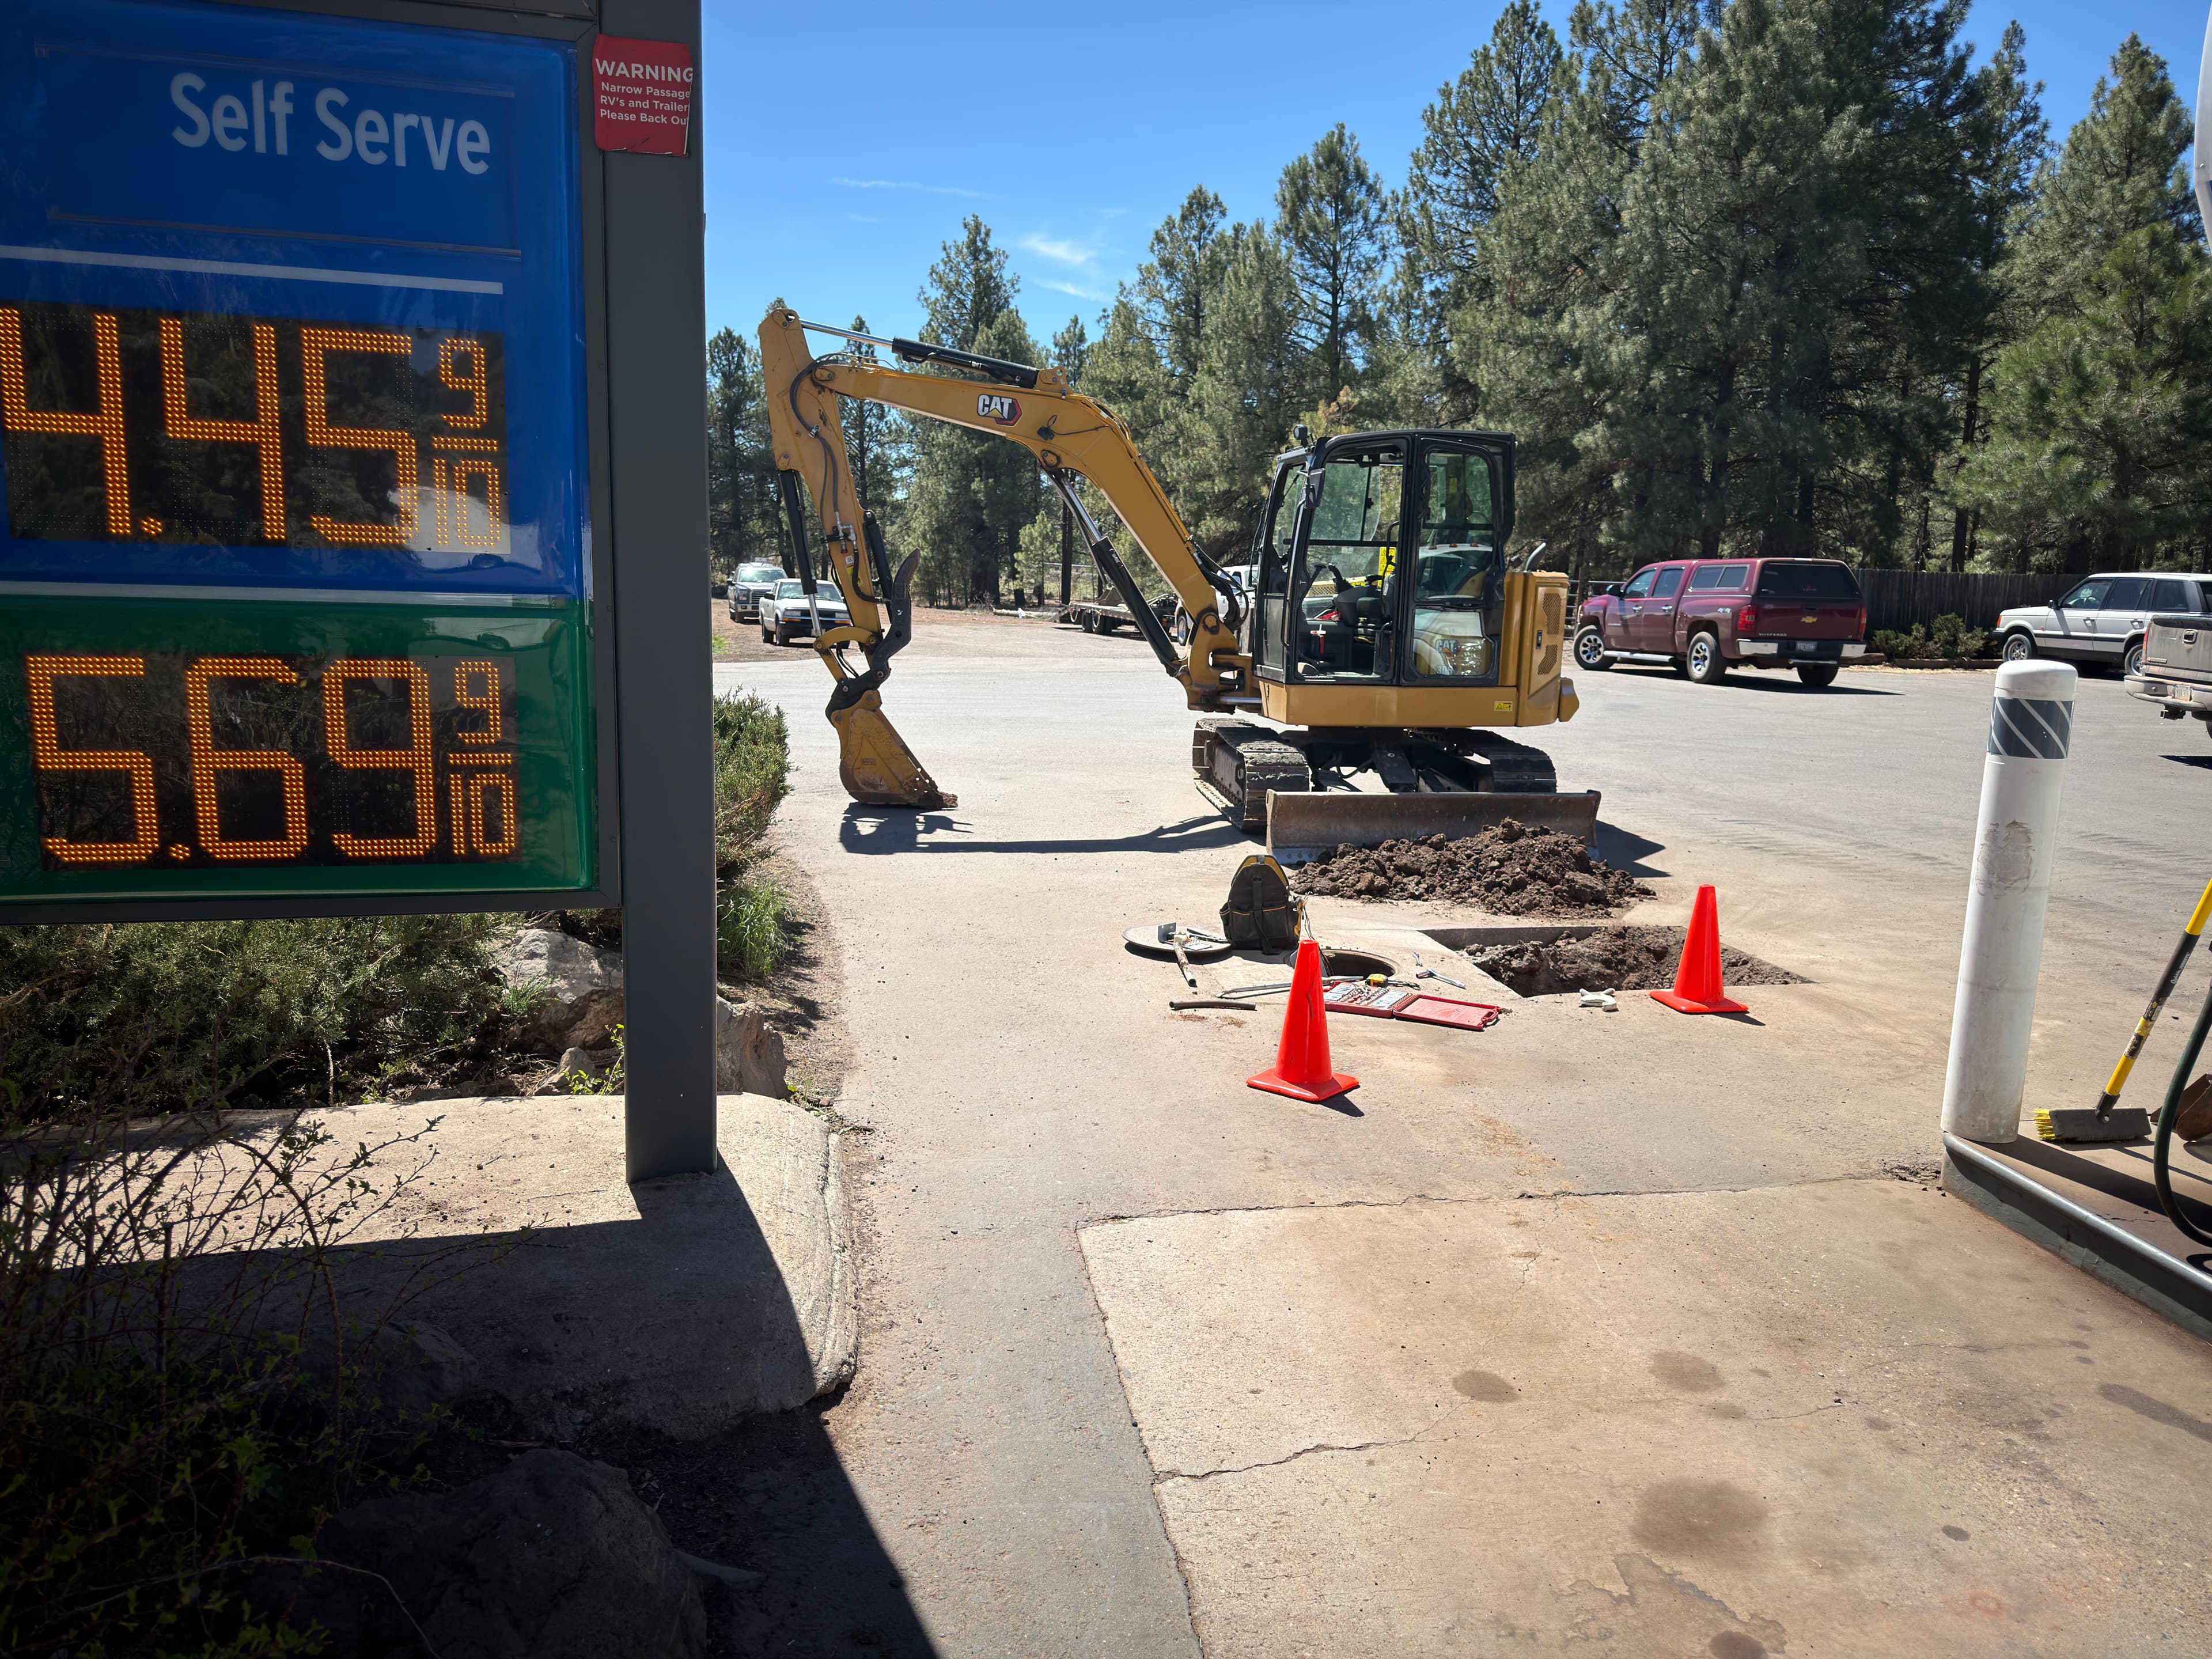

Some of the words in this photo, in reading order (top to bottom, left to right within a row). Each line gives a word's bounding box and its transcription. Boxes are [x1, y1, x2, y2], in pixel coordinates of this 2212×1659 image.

[595, 58, 693, 83] WARNING
[600, 95, 625, 107] RV's
[628, 100, 649, 108] and
[601, 82, 642, 94] Narrow
[646, 86, 690, 100] Passage
[169, 73, 294, 156] Self
[314, 87, 491, 175] Serve
[600, 109, 636, 121] Please
[640, 113, 668, 124] Back
[978, 394, 1012, 419] CAT
[1435, 638, 1456, 654] CAT
[26, 654, 437, 863] 5.69
[449, 772, 516, 856] 10
